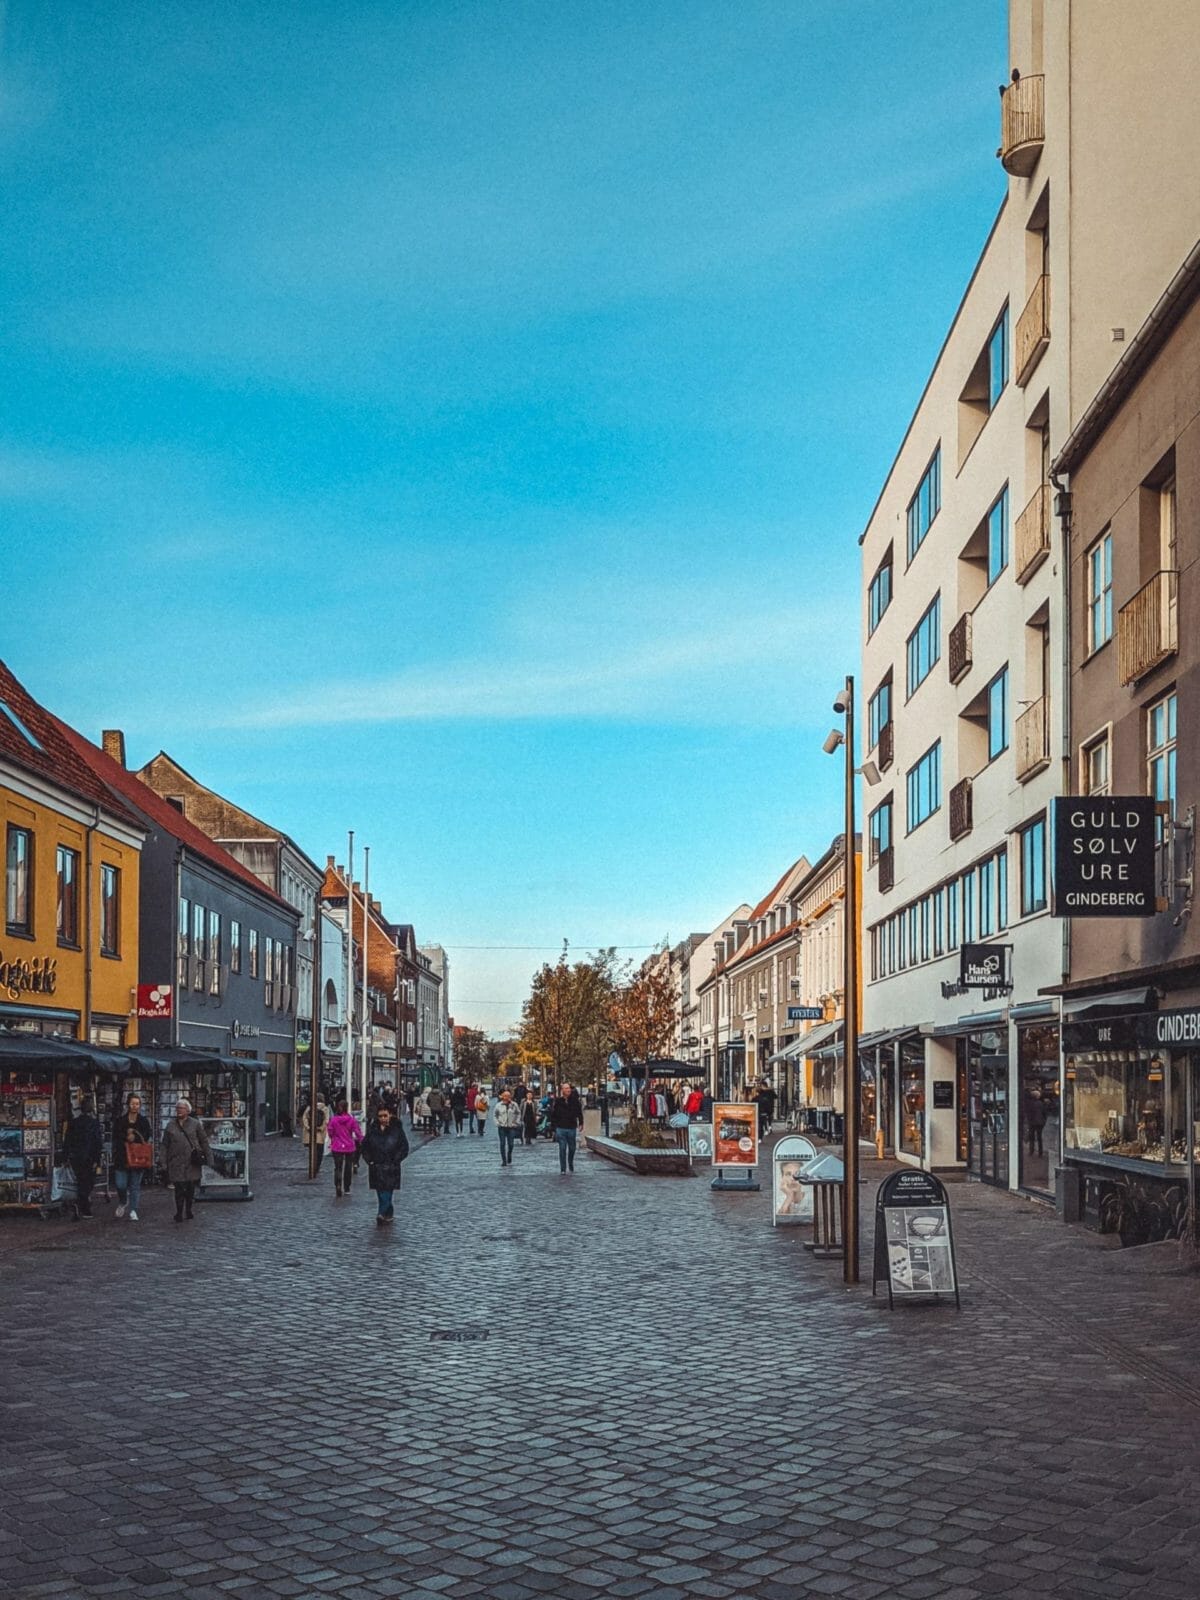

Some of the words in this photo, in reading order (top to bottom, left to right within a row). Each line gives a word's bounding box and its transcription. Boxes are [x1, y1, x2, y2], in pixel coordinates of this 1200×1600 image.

[1070, 811, 1140, 829] GULD
[1073, 836, 1137, 856] SØLV
[1081, 864, 1129, 880] URE
[1065, 892, 1145, 906] GINDEBERG
[0, 951, 58, 1001] og&idé
[968, 963, 991, 975] Hans
[964, 972, 998, 984] Laursen
[791, 1008, 820, 1018] matas
[1098, 1027, 1112, 1042] URE
[901, 1175, 924, 1183] Gratis
